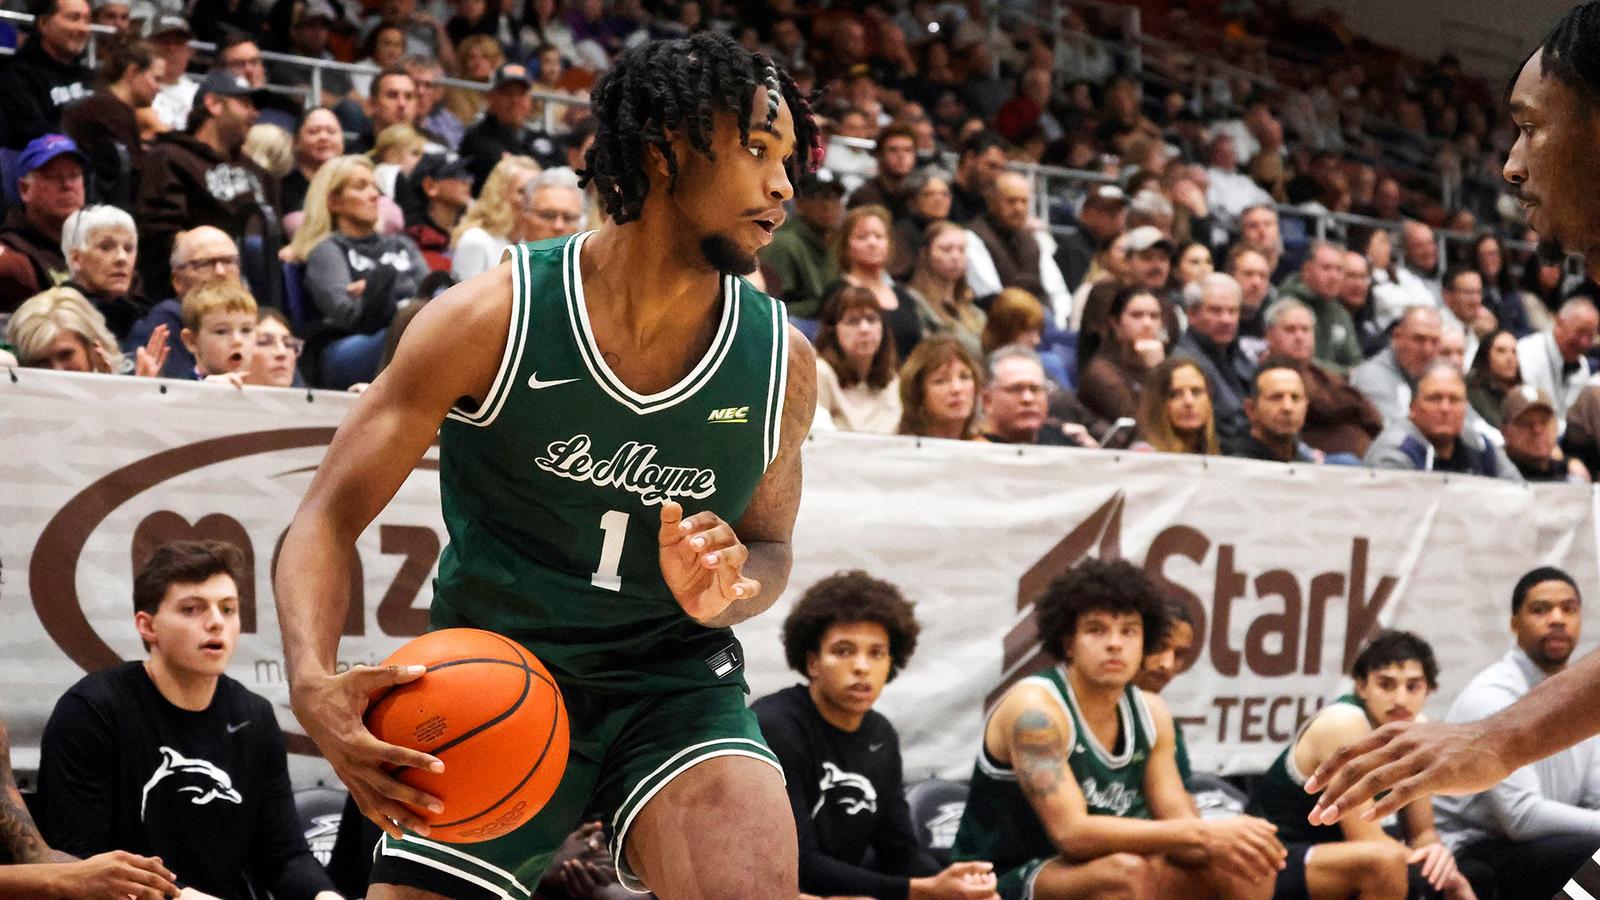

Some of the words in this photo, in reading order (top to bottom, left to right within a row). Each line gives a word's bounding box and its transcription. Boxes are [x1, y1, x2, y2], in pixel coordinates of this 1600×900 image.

[707, 406, 750, 420] NEC
[591, 510, 630, 592] 1
[1142, 524, 1399, 678] Stark
